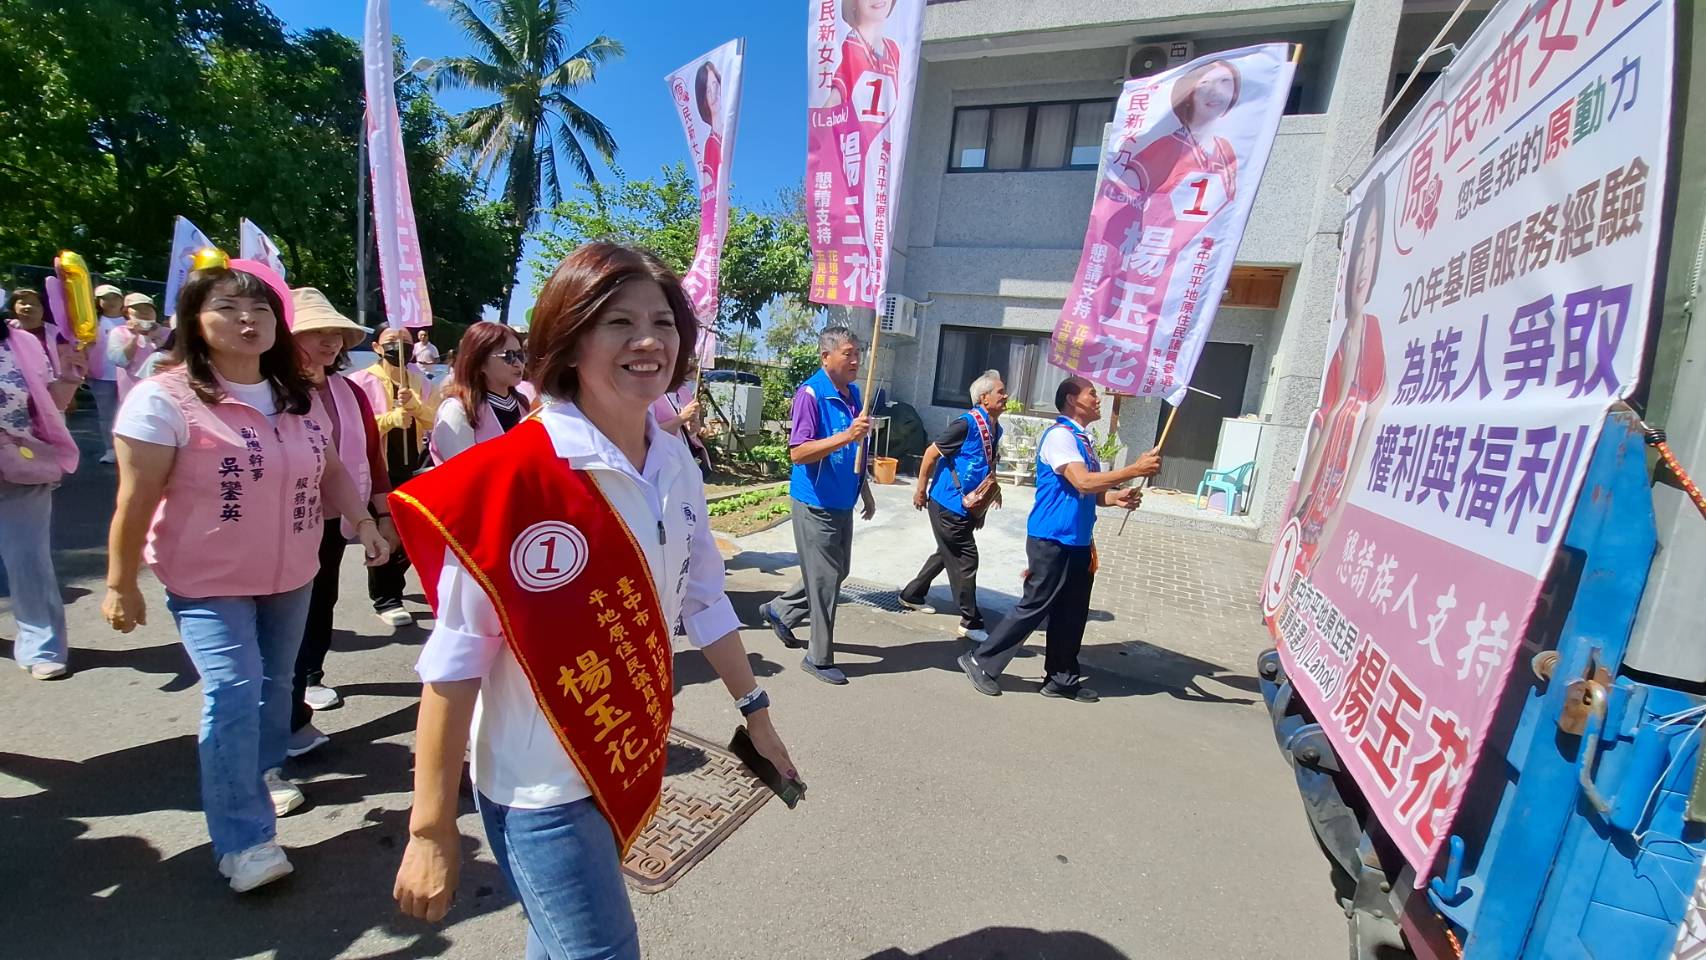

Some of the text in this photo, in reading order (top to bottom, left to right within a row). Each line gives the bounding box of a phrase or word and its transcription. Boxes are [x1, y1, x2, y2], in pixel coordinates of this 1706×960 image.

[862, 79, 885, 117] 1
[1400, 0, 1628, 228] 原民新女
[1454, 55, 1642, 220] 您是我的原動力
[814, 171, 832, 245] 懇請支持
[1183, 178, 1209, 216] 1
[1398, 155, 1650, 325] 20年基層服務經驗
[1072, 243, 1108, 319] 懇請支持
[1087, 221, 1174, 388] 楊玉花
[1391, 283, 1634, 406] 為族人爭取
[1367, 423, 1590, 544] 權利與福利
[536, 536, 560, 574] 1
[1336, 529, 1510, 697] 懇請族人支持
[556, 650, 649, 775] 楊玉花
[1333, 638, 1470, 848] 楊玉花
